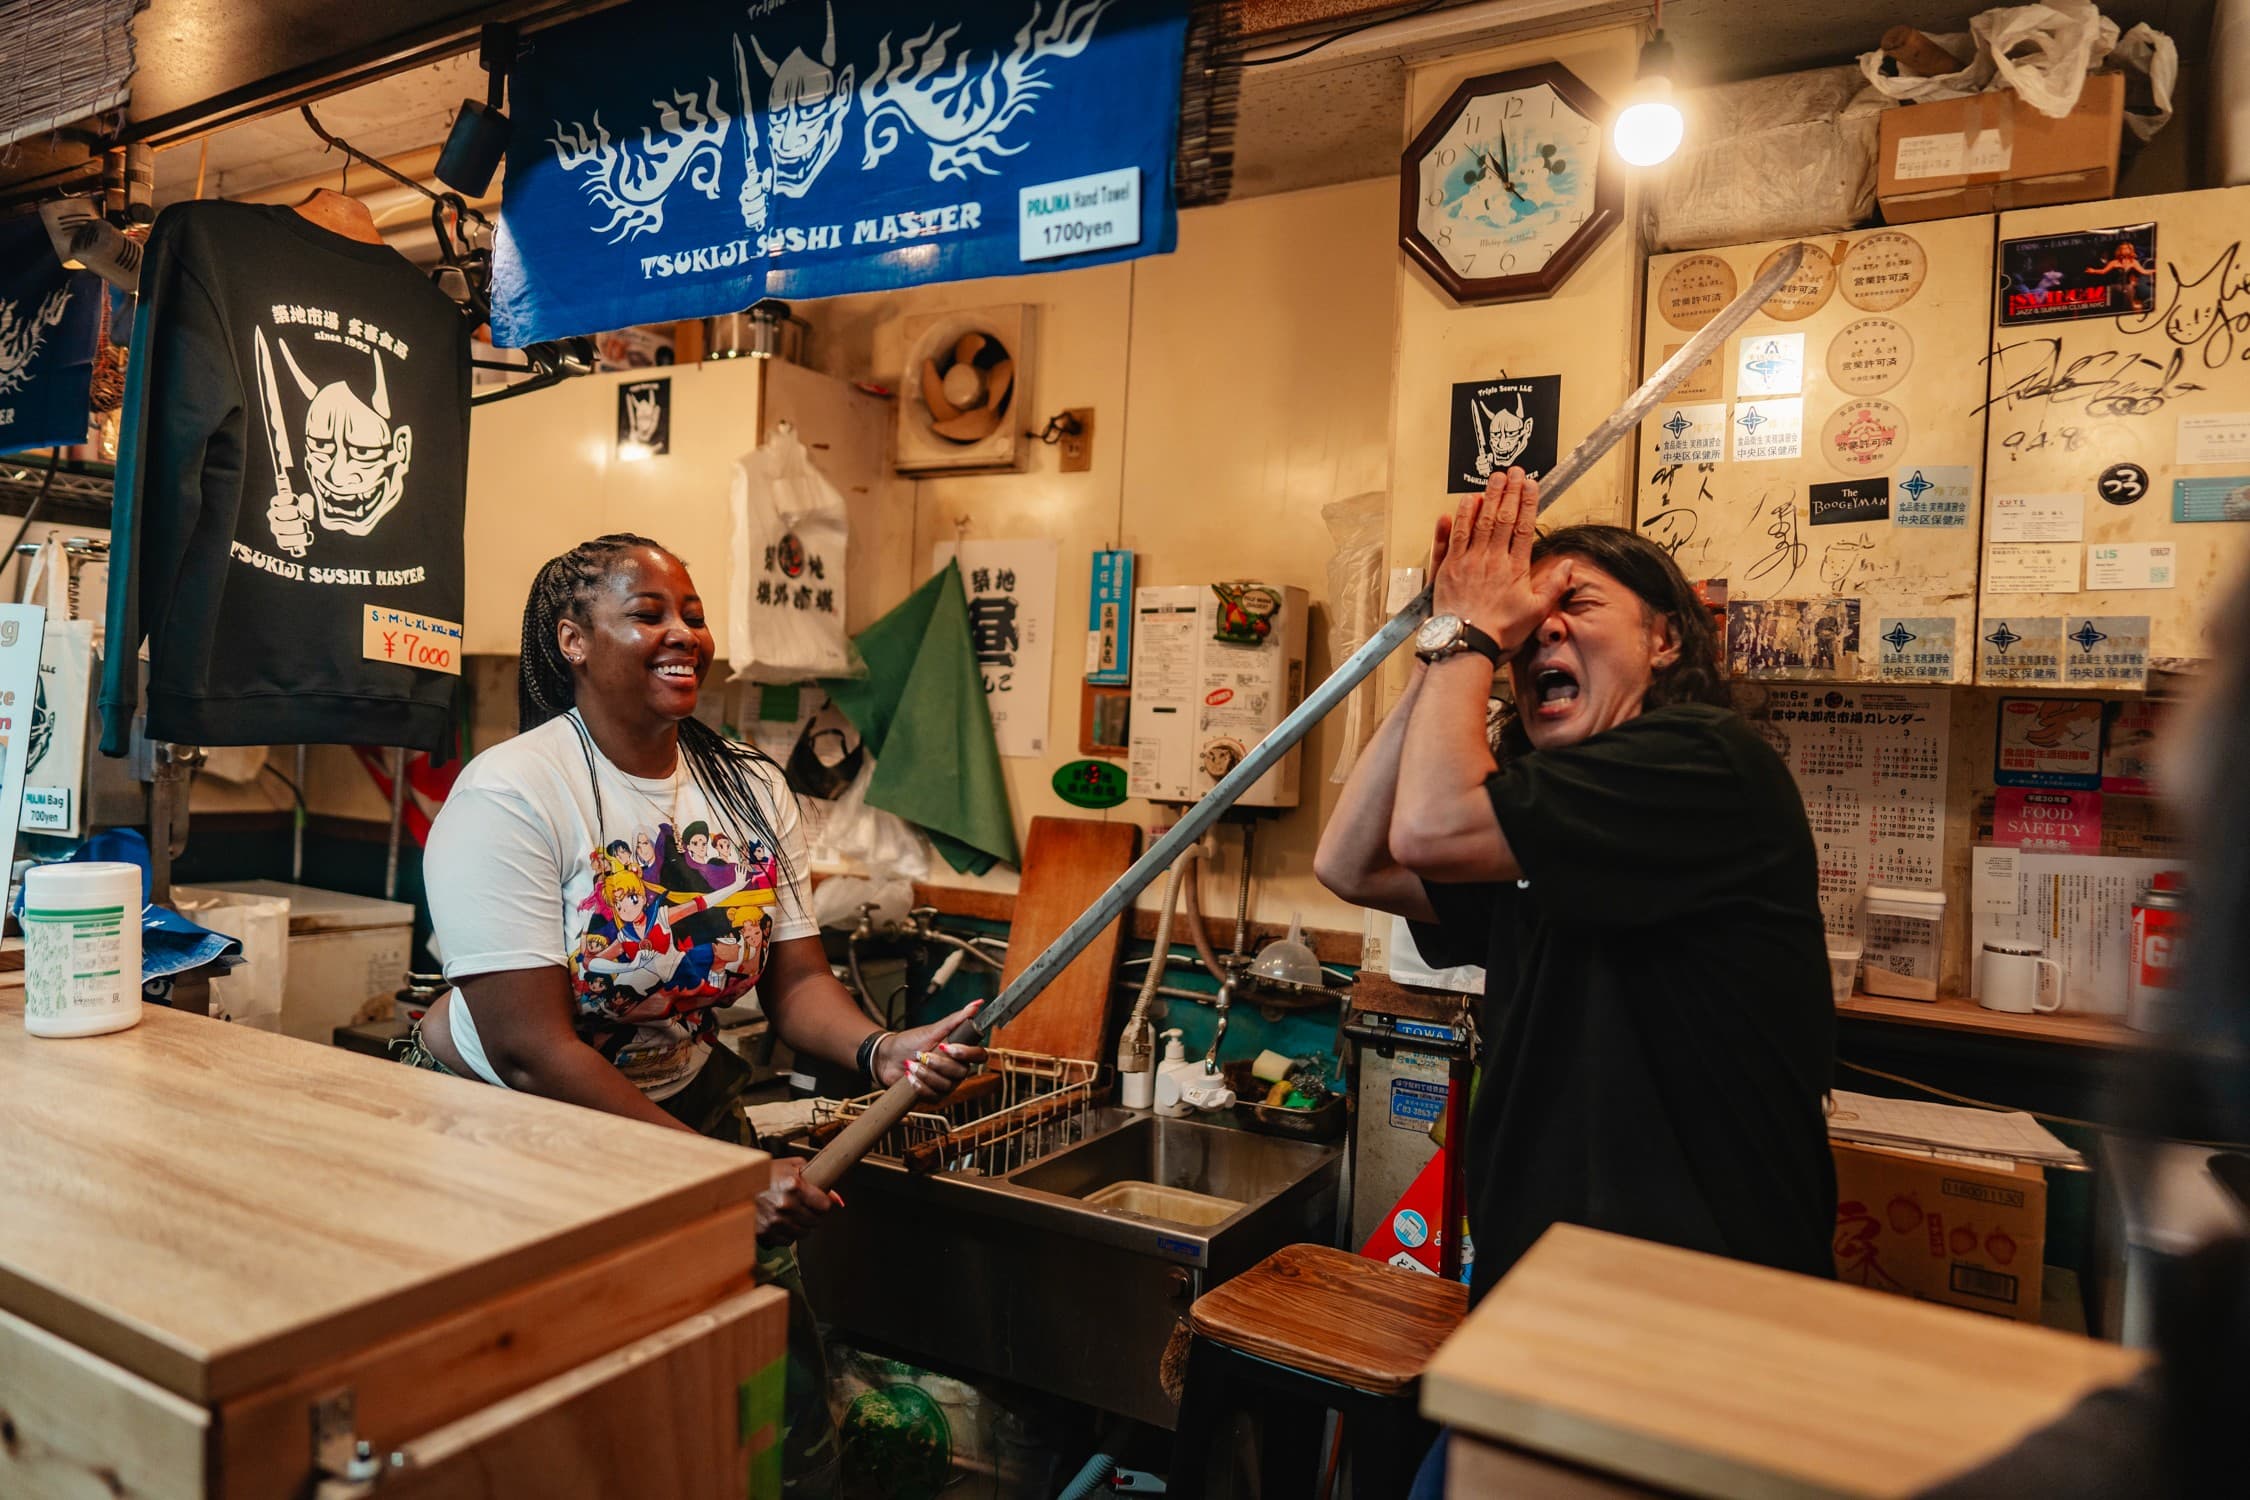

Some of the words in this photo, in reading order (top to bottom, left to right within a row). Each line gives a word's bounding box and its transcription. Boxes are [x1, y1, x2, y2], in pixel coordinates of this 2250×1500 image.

[1504, 97, 1524, 119] 12
[1465, 113, 1480, 135] 11
[1434, 149, 1456, 168] 10
[1043, 221, 1112, 244] 1700yen
[1437, 226, 1453, 247] 8
[641, 239, 750, 280] TSUKIJI
[754, 224, 842, 259] SUSHI
[851, 201, 982, 246] MASTER
[1460, 253, 1477, 275] 7
[1499, 248, 1516, 273] 6
[1779, 284, 1820, 296] 業許可済
[271, 304, 339, 331] 築地市場
[1664, 439, 1689, 450] 食品衛生
[1737, 445, 1798, 458] 中央区保健所
[1663, 449, 1721, 462] 中央区保健所
[1841, 488, 1859, 498] The
[1899, 502, 1928, 513] 食品衛生
[1897, 515, 1965, 526] 中央区保健所
[309, 567, 372, 585] SUSHI
[376, 566, 426, 586] MASTER
[972, 567, 1017, 592] 築地
[1883, 653, 1912, 665] 食品衛生
[1985, 655, 2016, 667] 食品衛生
[2070, 654, 2101, 665] 食品衛生
[1882, 666, 1950, 677] 中央区保健所
[1985, 668, 2057, 680] 中央区保健所
[2069, 667, 2143, 679] 中央区保健所
[47, 795, 64, 808] Bag
[31, 810, 58, 824] 700yen
[2021, 806, 2074, 820] FOOD
[2007, 820, 2086, 838] SAFETY
[1402, 1026, 1444, 1040] TOWA
